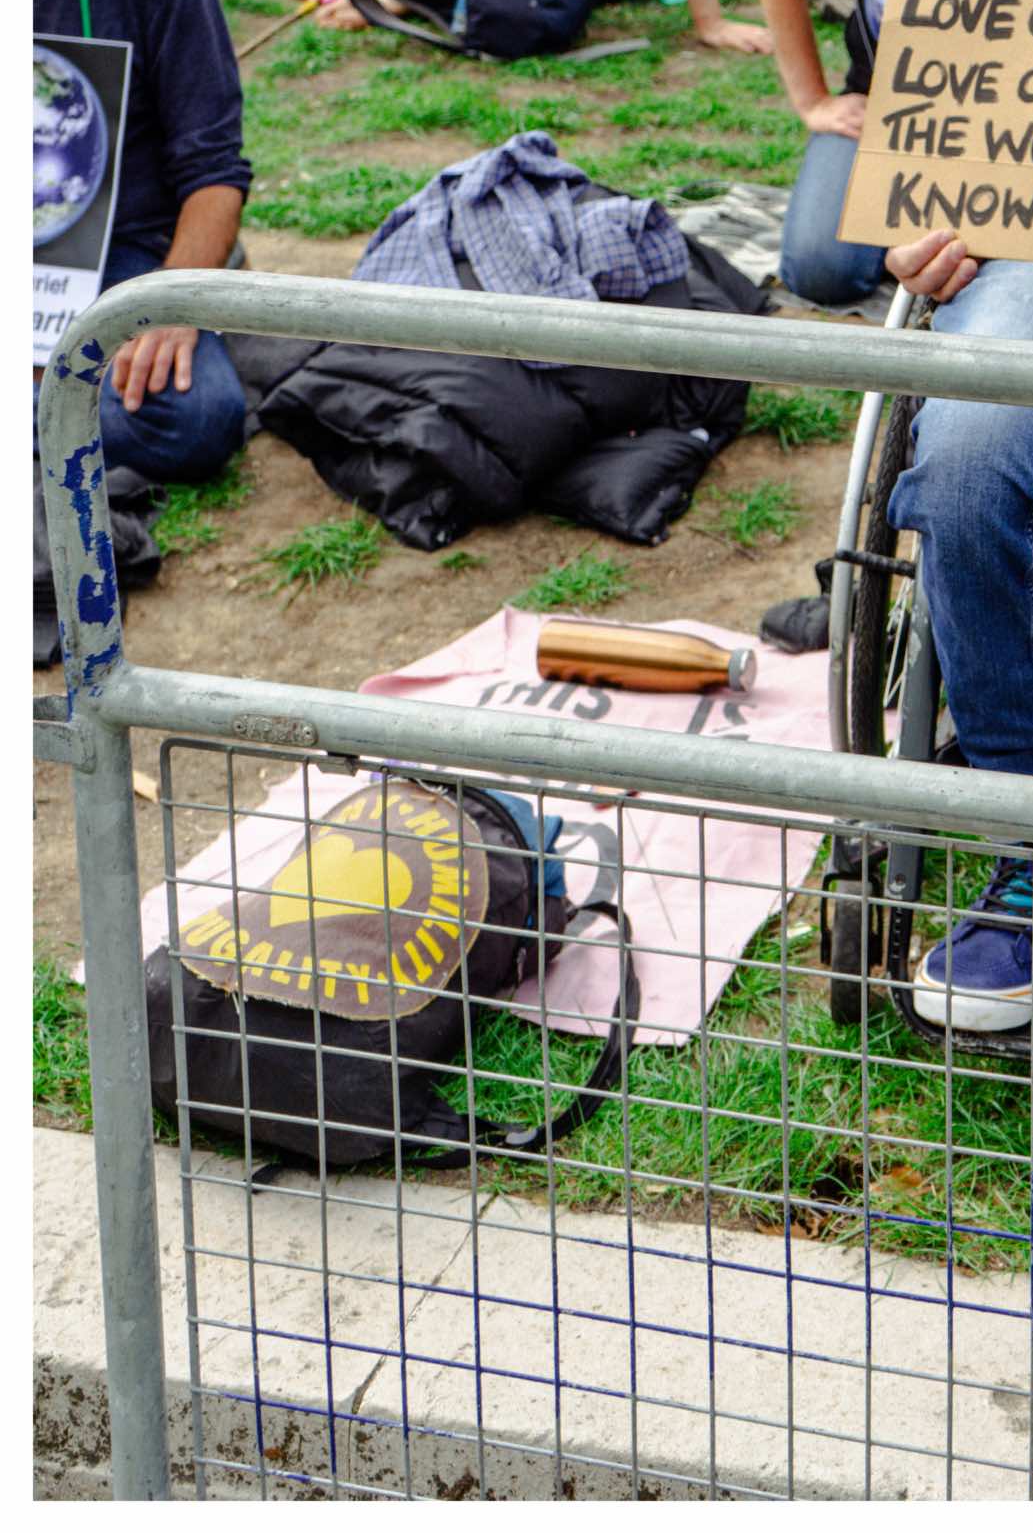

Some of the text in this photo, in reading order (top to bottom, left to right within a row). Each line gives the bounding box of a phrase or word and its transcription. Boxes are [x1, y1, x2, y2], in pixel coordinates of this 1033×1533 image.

[892, 46, 1003, 103] LOVE
[882, 102, 969, 157] THE
[33, 273, 70, 294] rief
[33, 310, 75, 334] art
